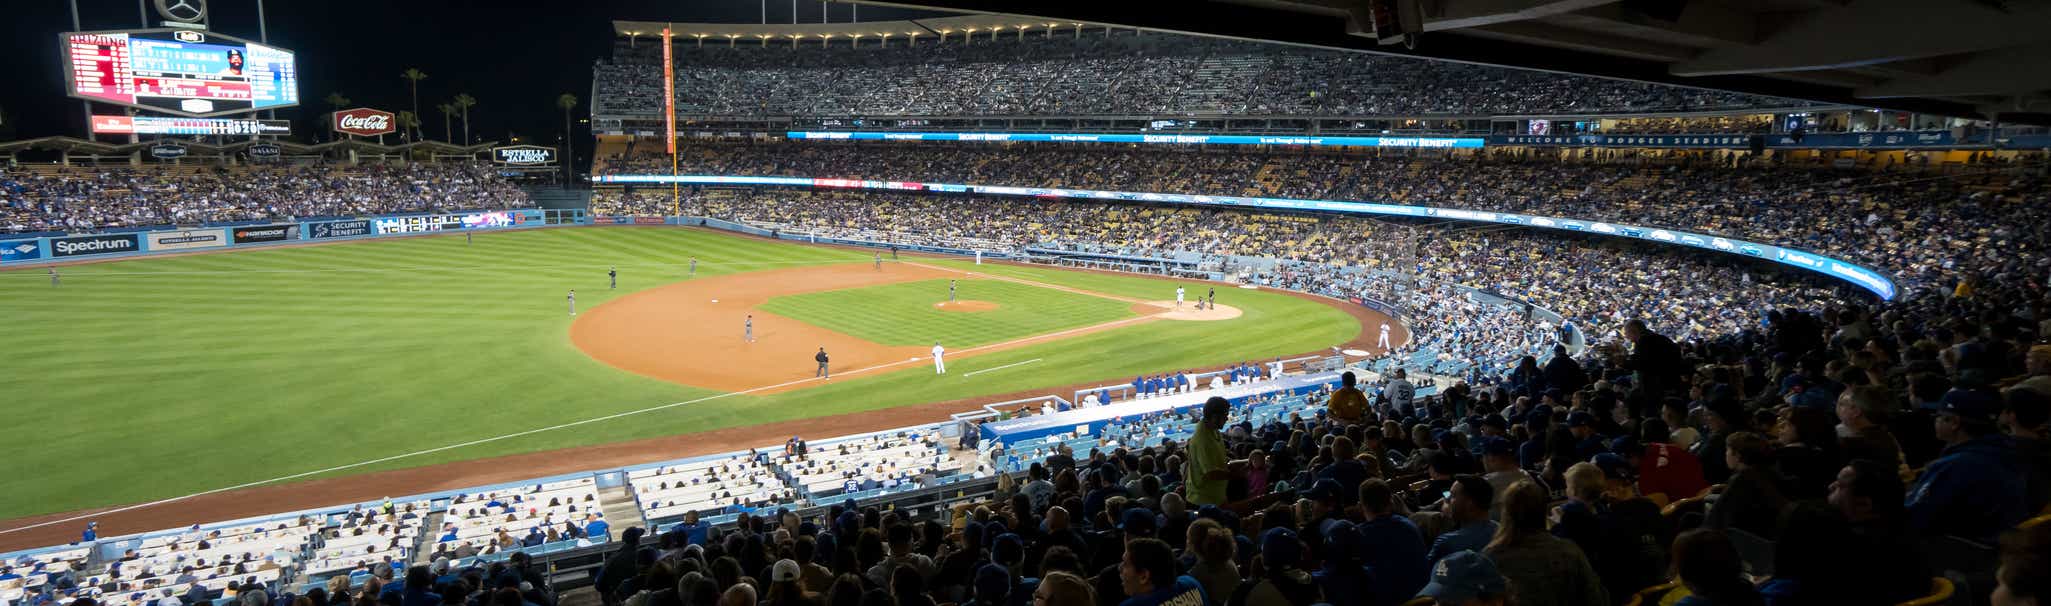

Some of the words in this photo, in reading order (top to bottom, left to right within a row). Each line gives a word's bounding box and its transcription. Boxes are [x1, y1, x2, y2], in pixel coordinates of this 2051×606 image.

[70, 34, 126, 47] ARIZONA
[340, 114, 389, 130] Coca-Cola
[243, 125, 249, 134] 2
[959, 133, 984, 141] SECURITY
[1144, 135, 1176, 143] SECURITY
[1379, 137, 1417, 147] SECURITY
[1674, 138, 1742, 146] STADIUM
[502, 149, 549, 157] ESTRELLA
[507, 154, 545, 163] JALISCO
[331, 222, 366, 230] SECURITY
[56, 239, 130, 254] Spectrum
